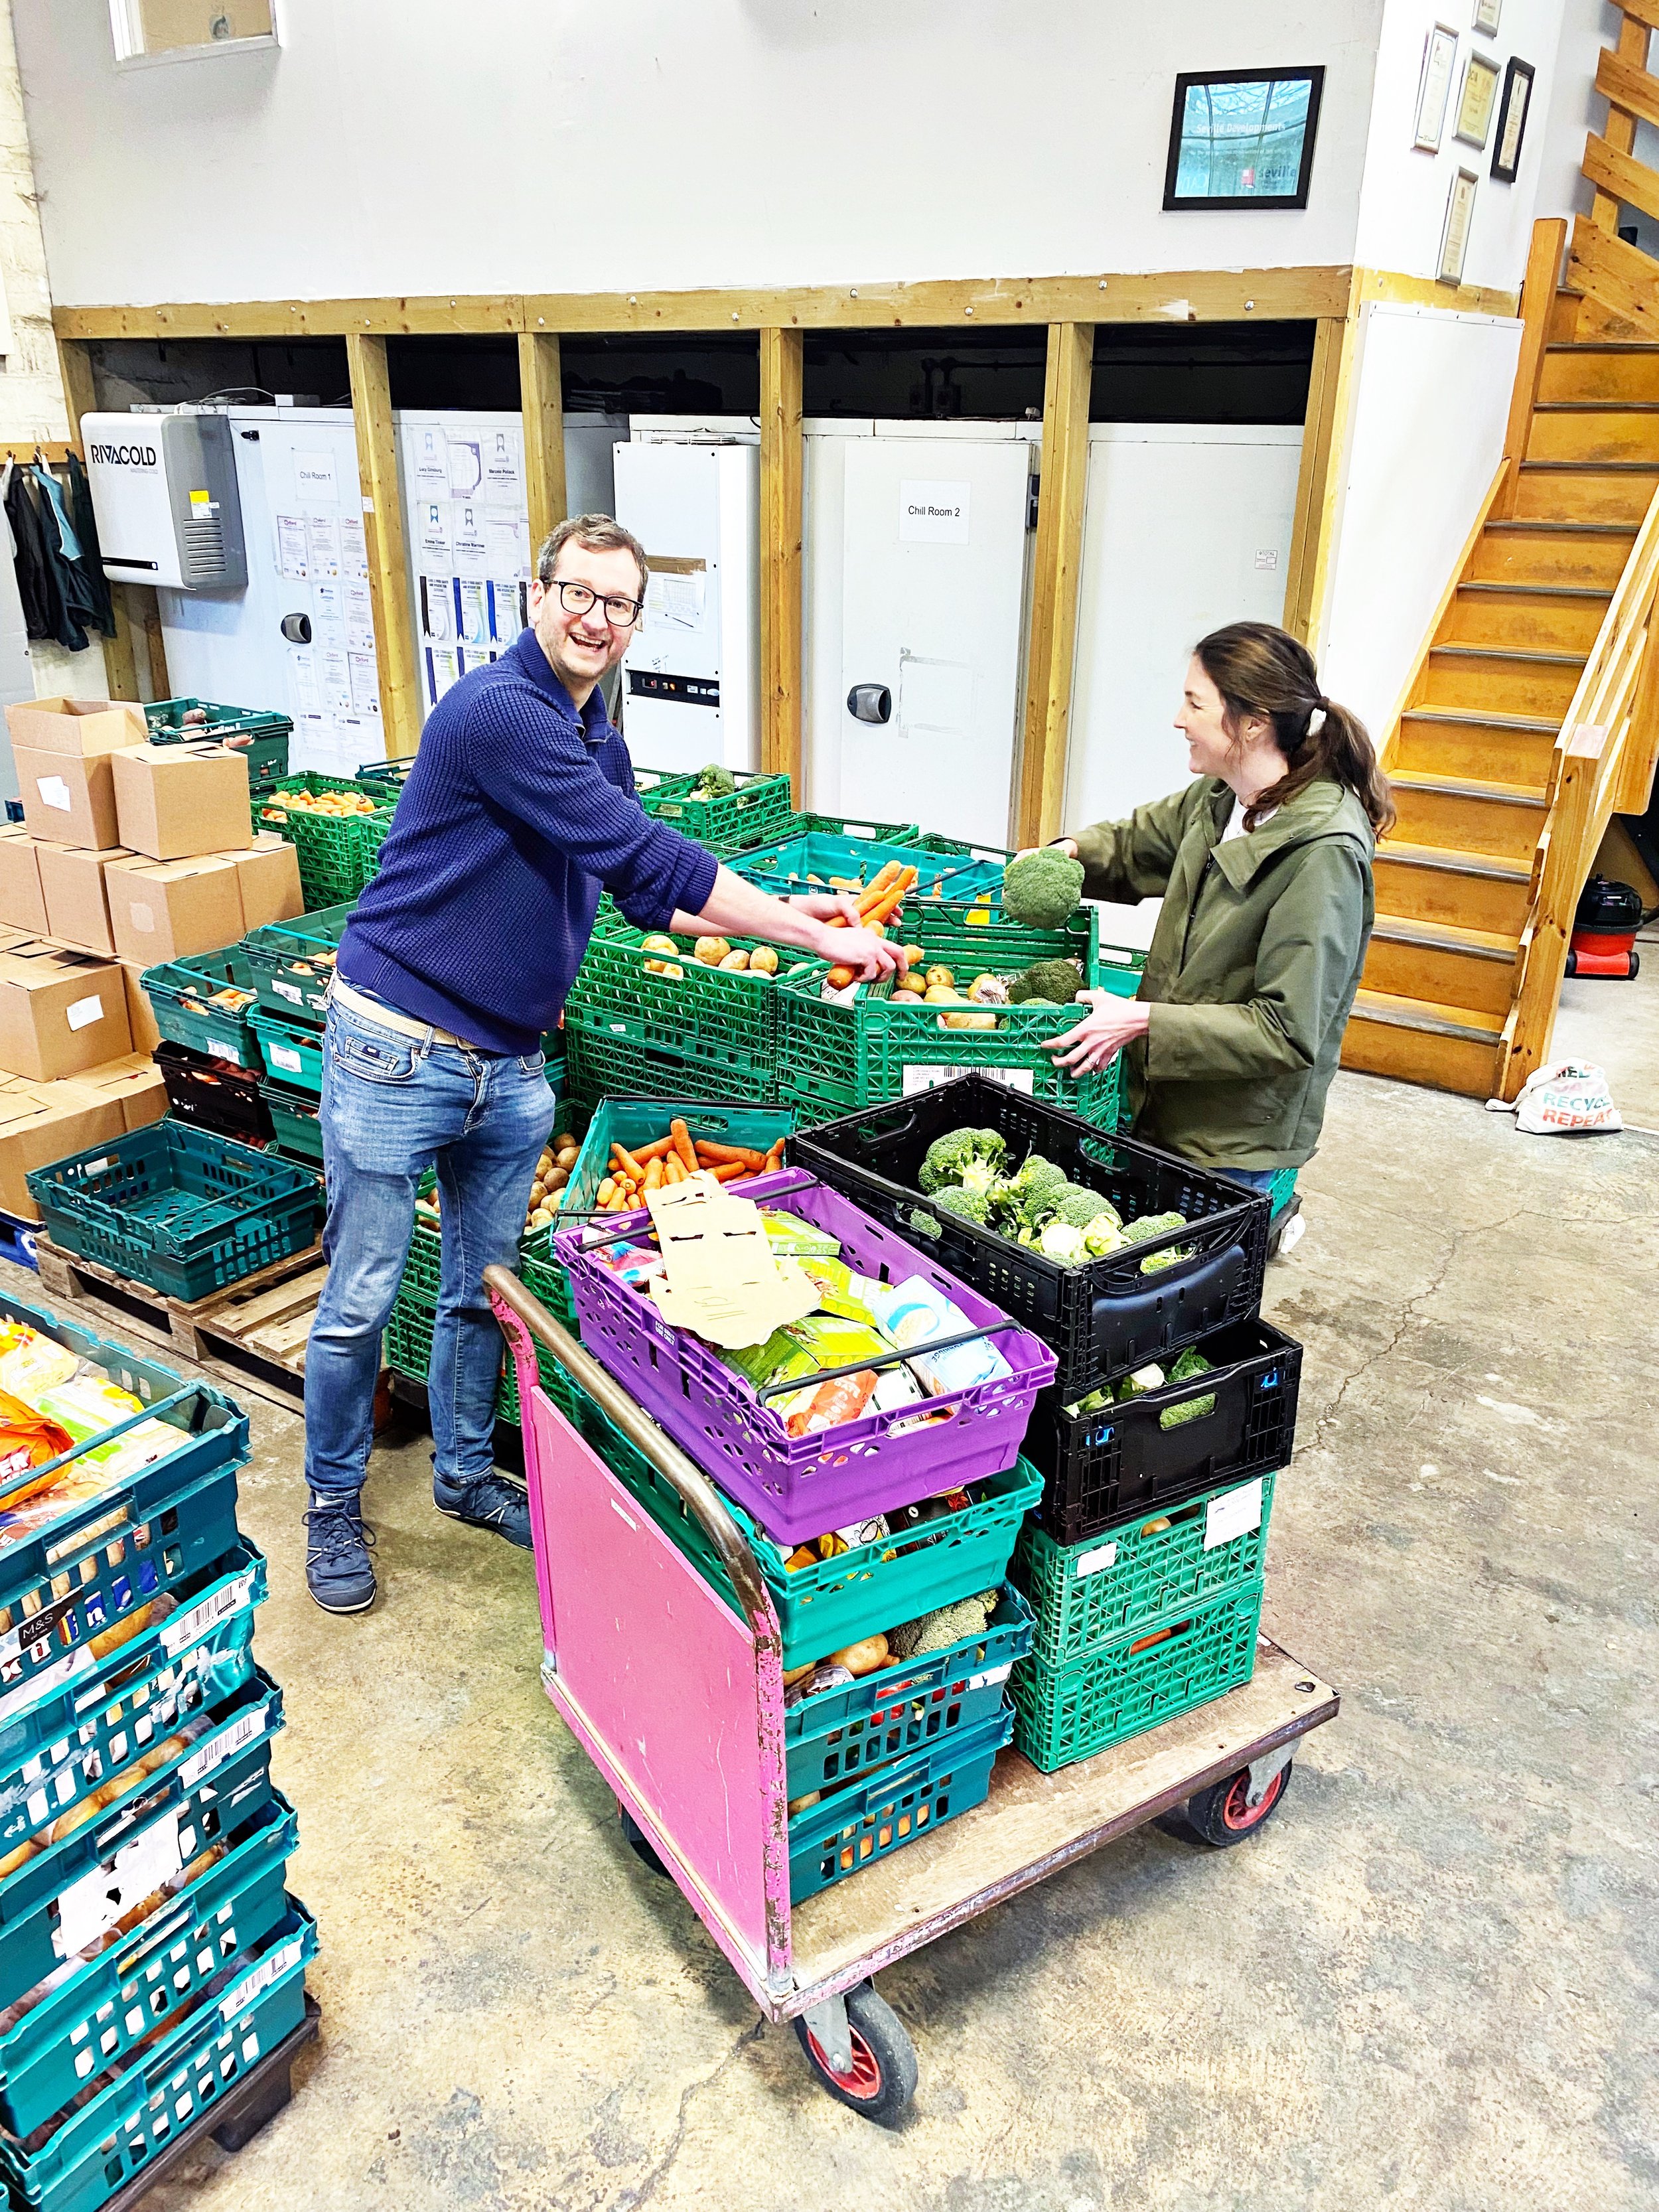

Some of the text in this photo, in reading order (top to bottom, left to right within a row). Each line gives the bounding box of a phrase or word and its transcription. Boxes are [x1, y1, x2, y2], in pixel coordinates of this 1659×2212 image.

[1196, 123, 1224, 133] Seville
[90, 445, 156, 466] RIVACOLD
[312, 472, 326, 480] Room
[908, 506, 960, 516] Chill Room 2
[23, 1613, 54, 1639] M&S
